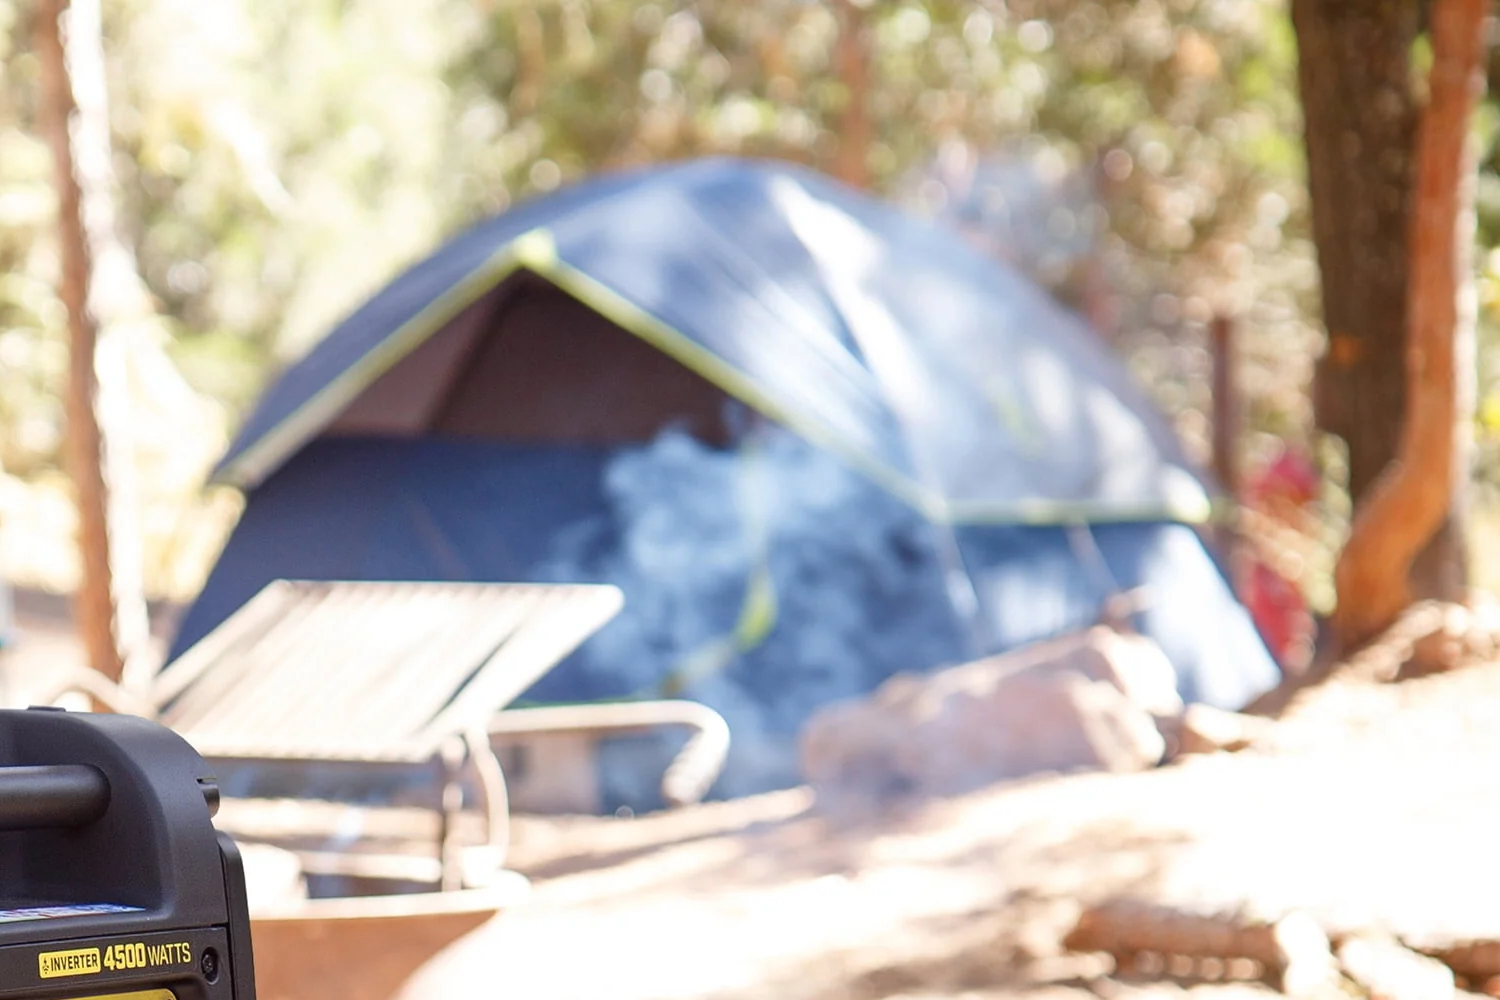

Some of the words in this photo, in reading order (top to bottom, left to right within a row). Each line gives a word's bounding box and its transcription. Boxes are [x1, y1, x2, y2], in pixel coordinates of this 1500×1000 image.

[51, 953, 98, 972] INVERTER
[103, 942, 147, 971] 4500
[147, 942, 192, 967] WATTS
